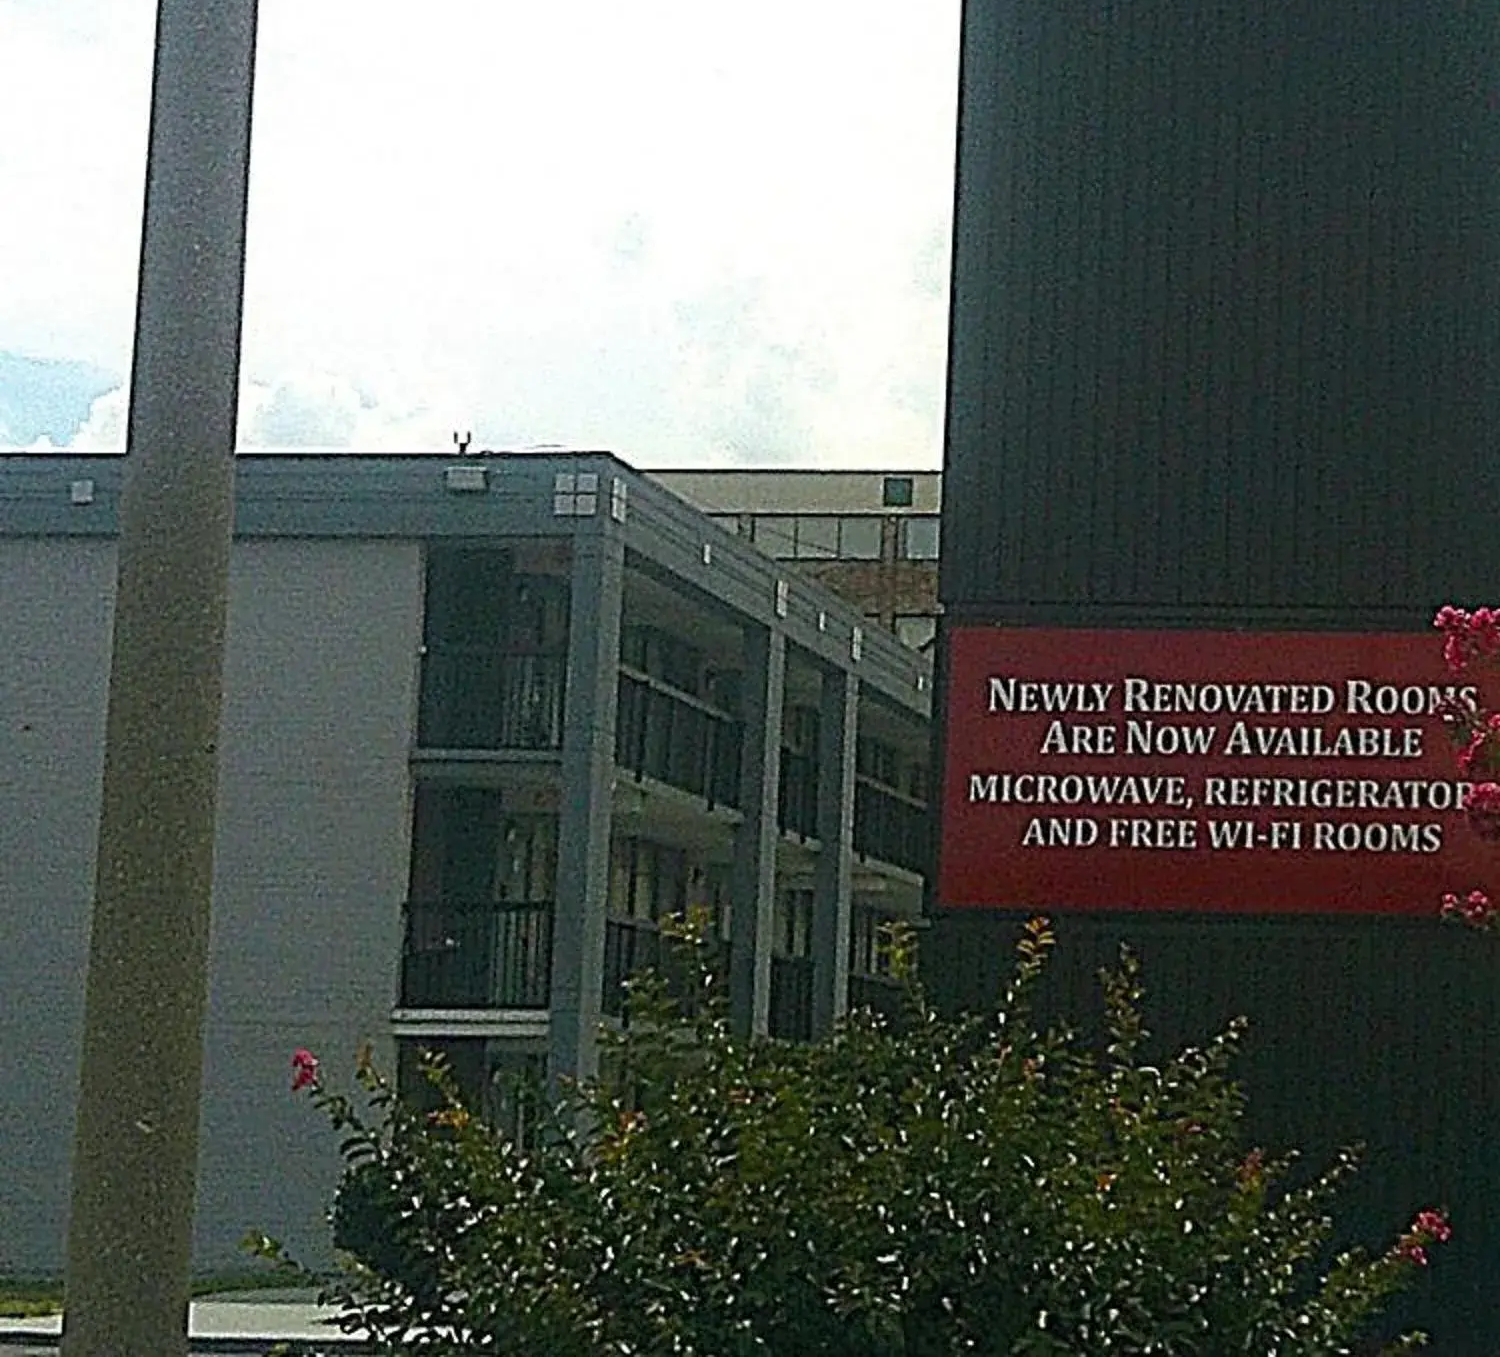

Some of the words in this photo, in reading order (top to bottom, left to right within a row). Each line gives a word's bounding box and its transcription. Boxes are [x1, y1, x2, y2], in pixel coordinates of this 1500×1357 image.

[988, 677, 1112, 714] NEWLY
[1124, 679, 1335, 715] RENOVATED
[1346, 679, 1478, 716] ROOMS
[1040, 721, 1114, 755] ARE
[1126, 721, 1215, 756] NOW
[1224, 721, 1423, 757] AVAILABLE
[968, 774, 1194, 810] MICROWAVE,
[1022, 817, 1097, 847] AND
[1109, 819, 1197, 848] FREE
[1208, 820, 1301, 850] WI-FI
[1314, 823, 1443, 853] ROOMS
